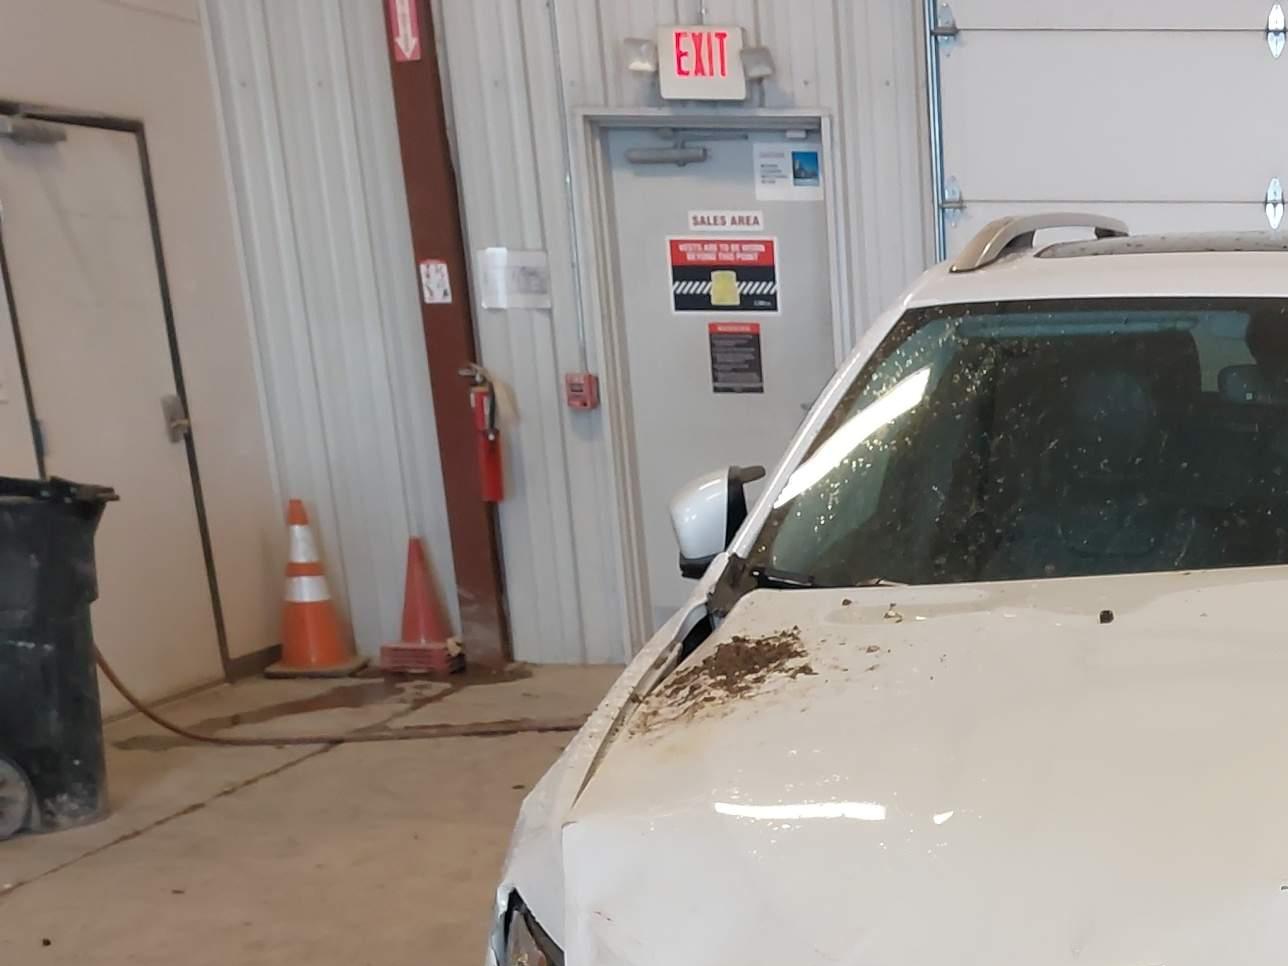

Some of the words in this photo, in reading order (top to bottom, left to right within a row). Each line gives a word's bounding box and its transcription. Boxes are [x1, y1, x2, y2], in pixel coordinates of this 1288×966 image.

[674, 31, 728, 77] EXIT
[692, 215, 727, 226] SALES
[730, 215, 760, 226] AREA
